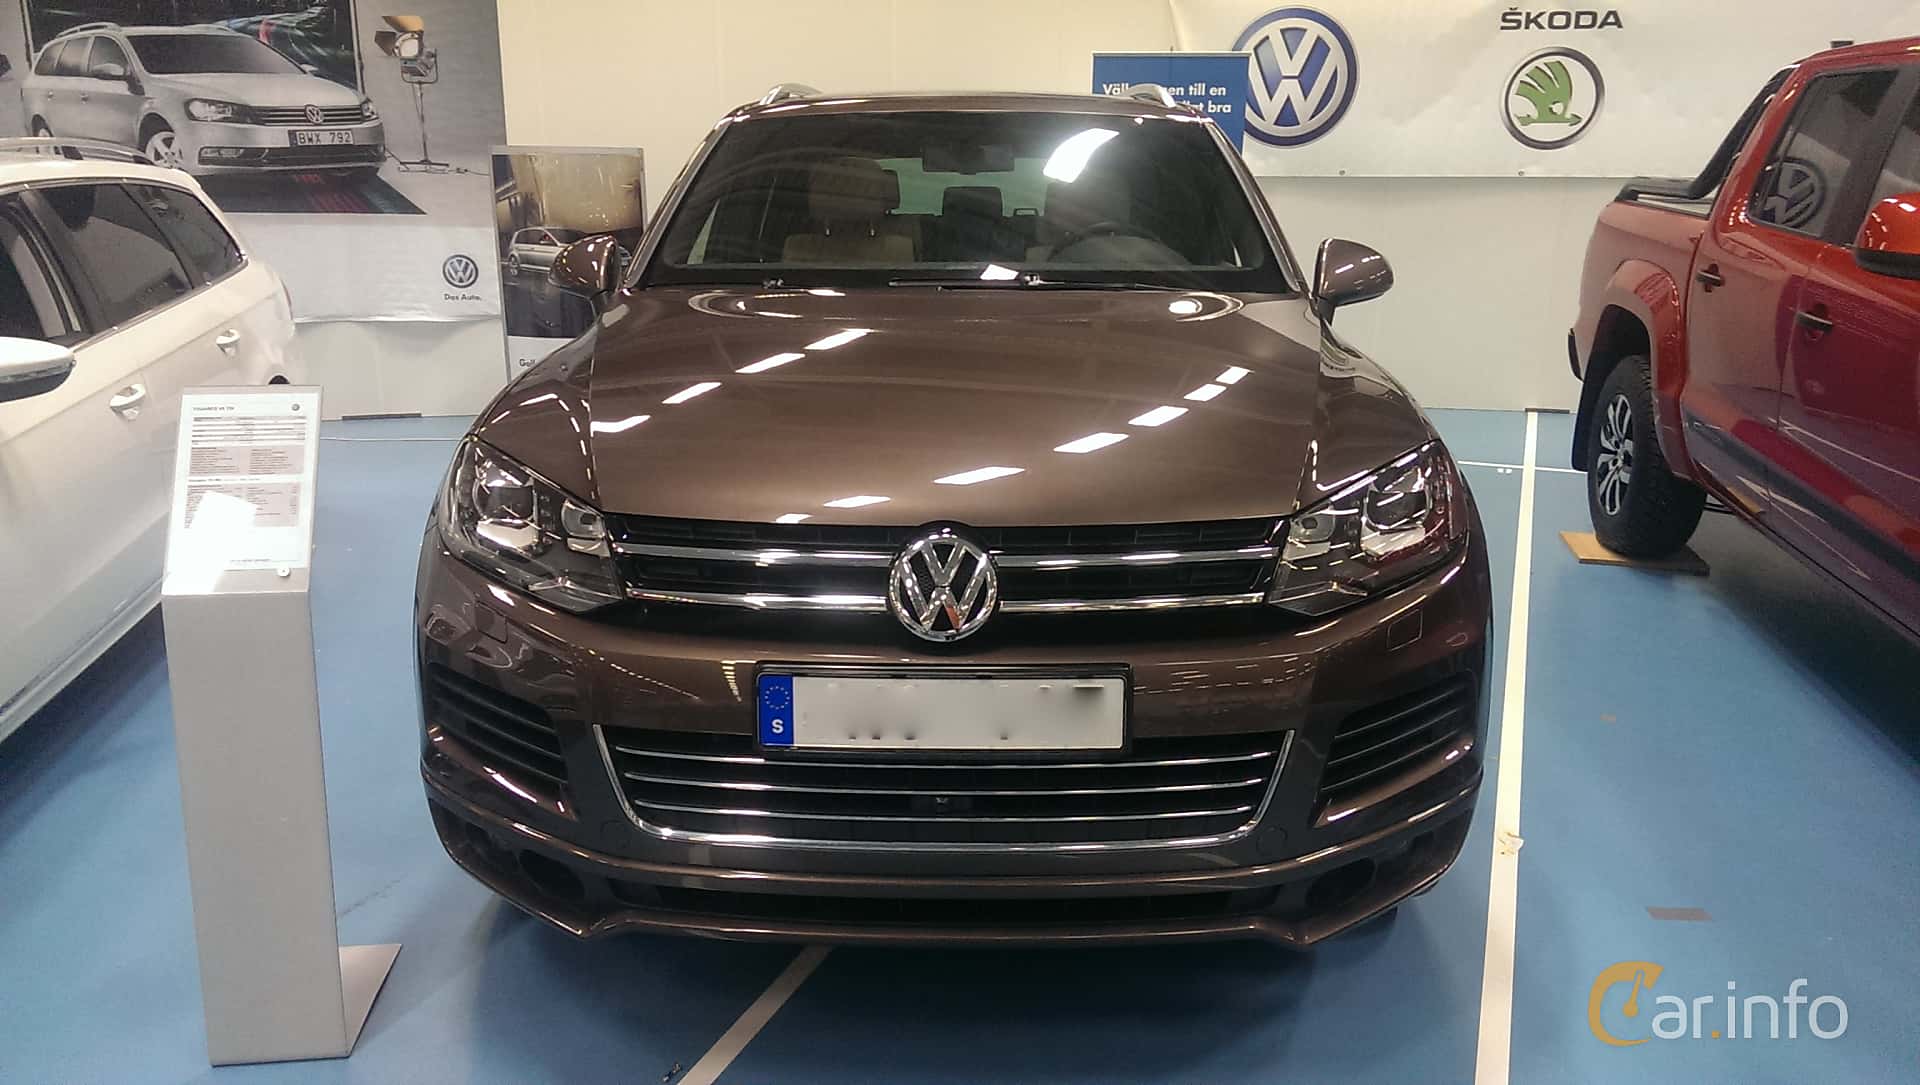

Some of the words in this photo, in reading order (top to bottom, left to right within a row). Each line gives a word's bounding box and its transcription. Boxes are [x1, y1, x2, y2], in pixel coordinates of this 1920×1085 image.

[1500, 7, 1623, 30] ŠKODA
[1189, 82, 1206, 96] till
[1209, 86, 1227, 96] en
[1207, 100, 1232, 113] bra
[329, 131, 351, 143] 792
[771, 718, 784, 734] S
